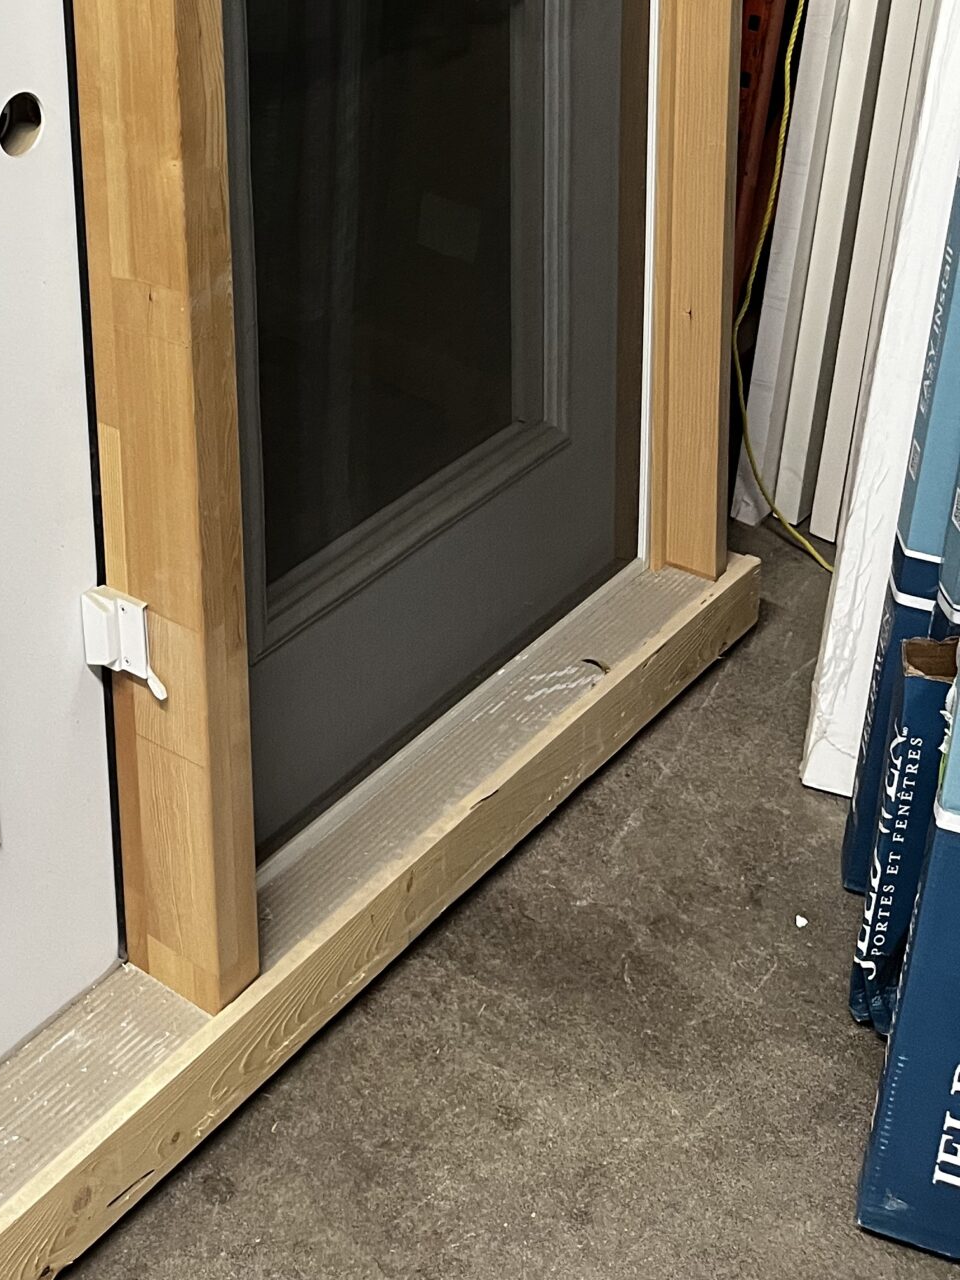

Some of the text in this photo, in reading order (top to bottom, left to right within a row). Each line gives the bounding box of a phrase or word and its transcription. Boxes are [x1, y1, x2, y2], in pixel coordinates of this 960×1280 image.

[871, 735, 924, 956] PORTES ET FENÊTRES
